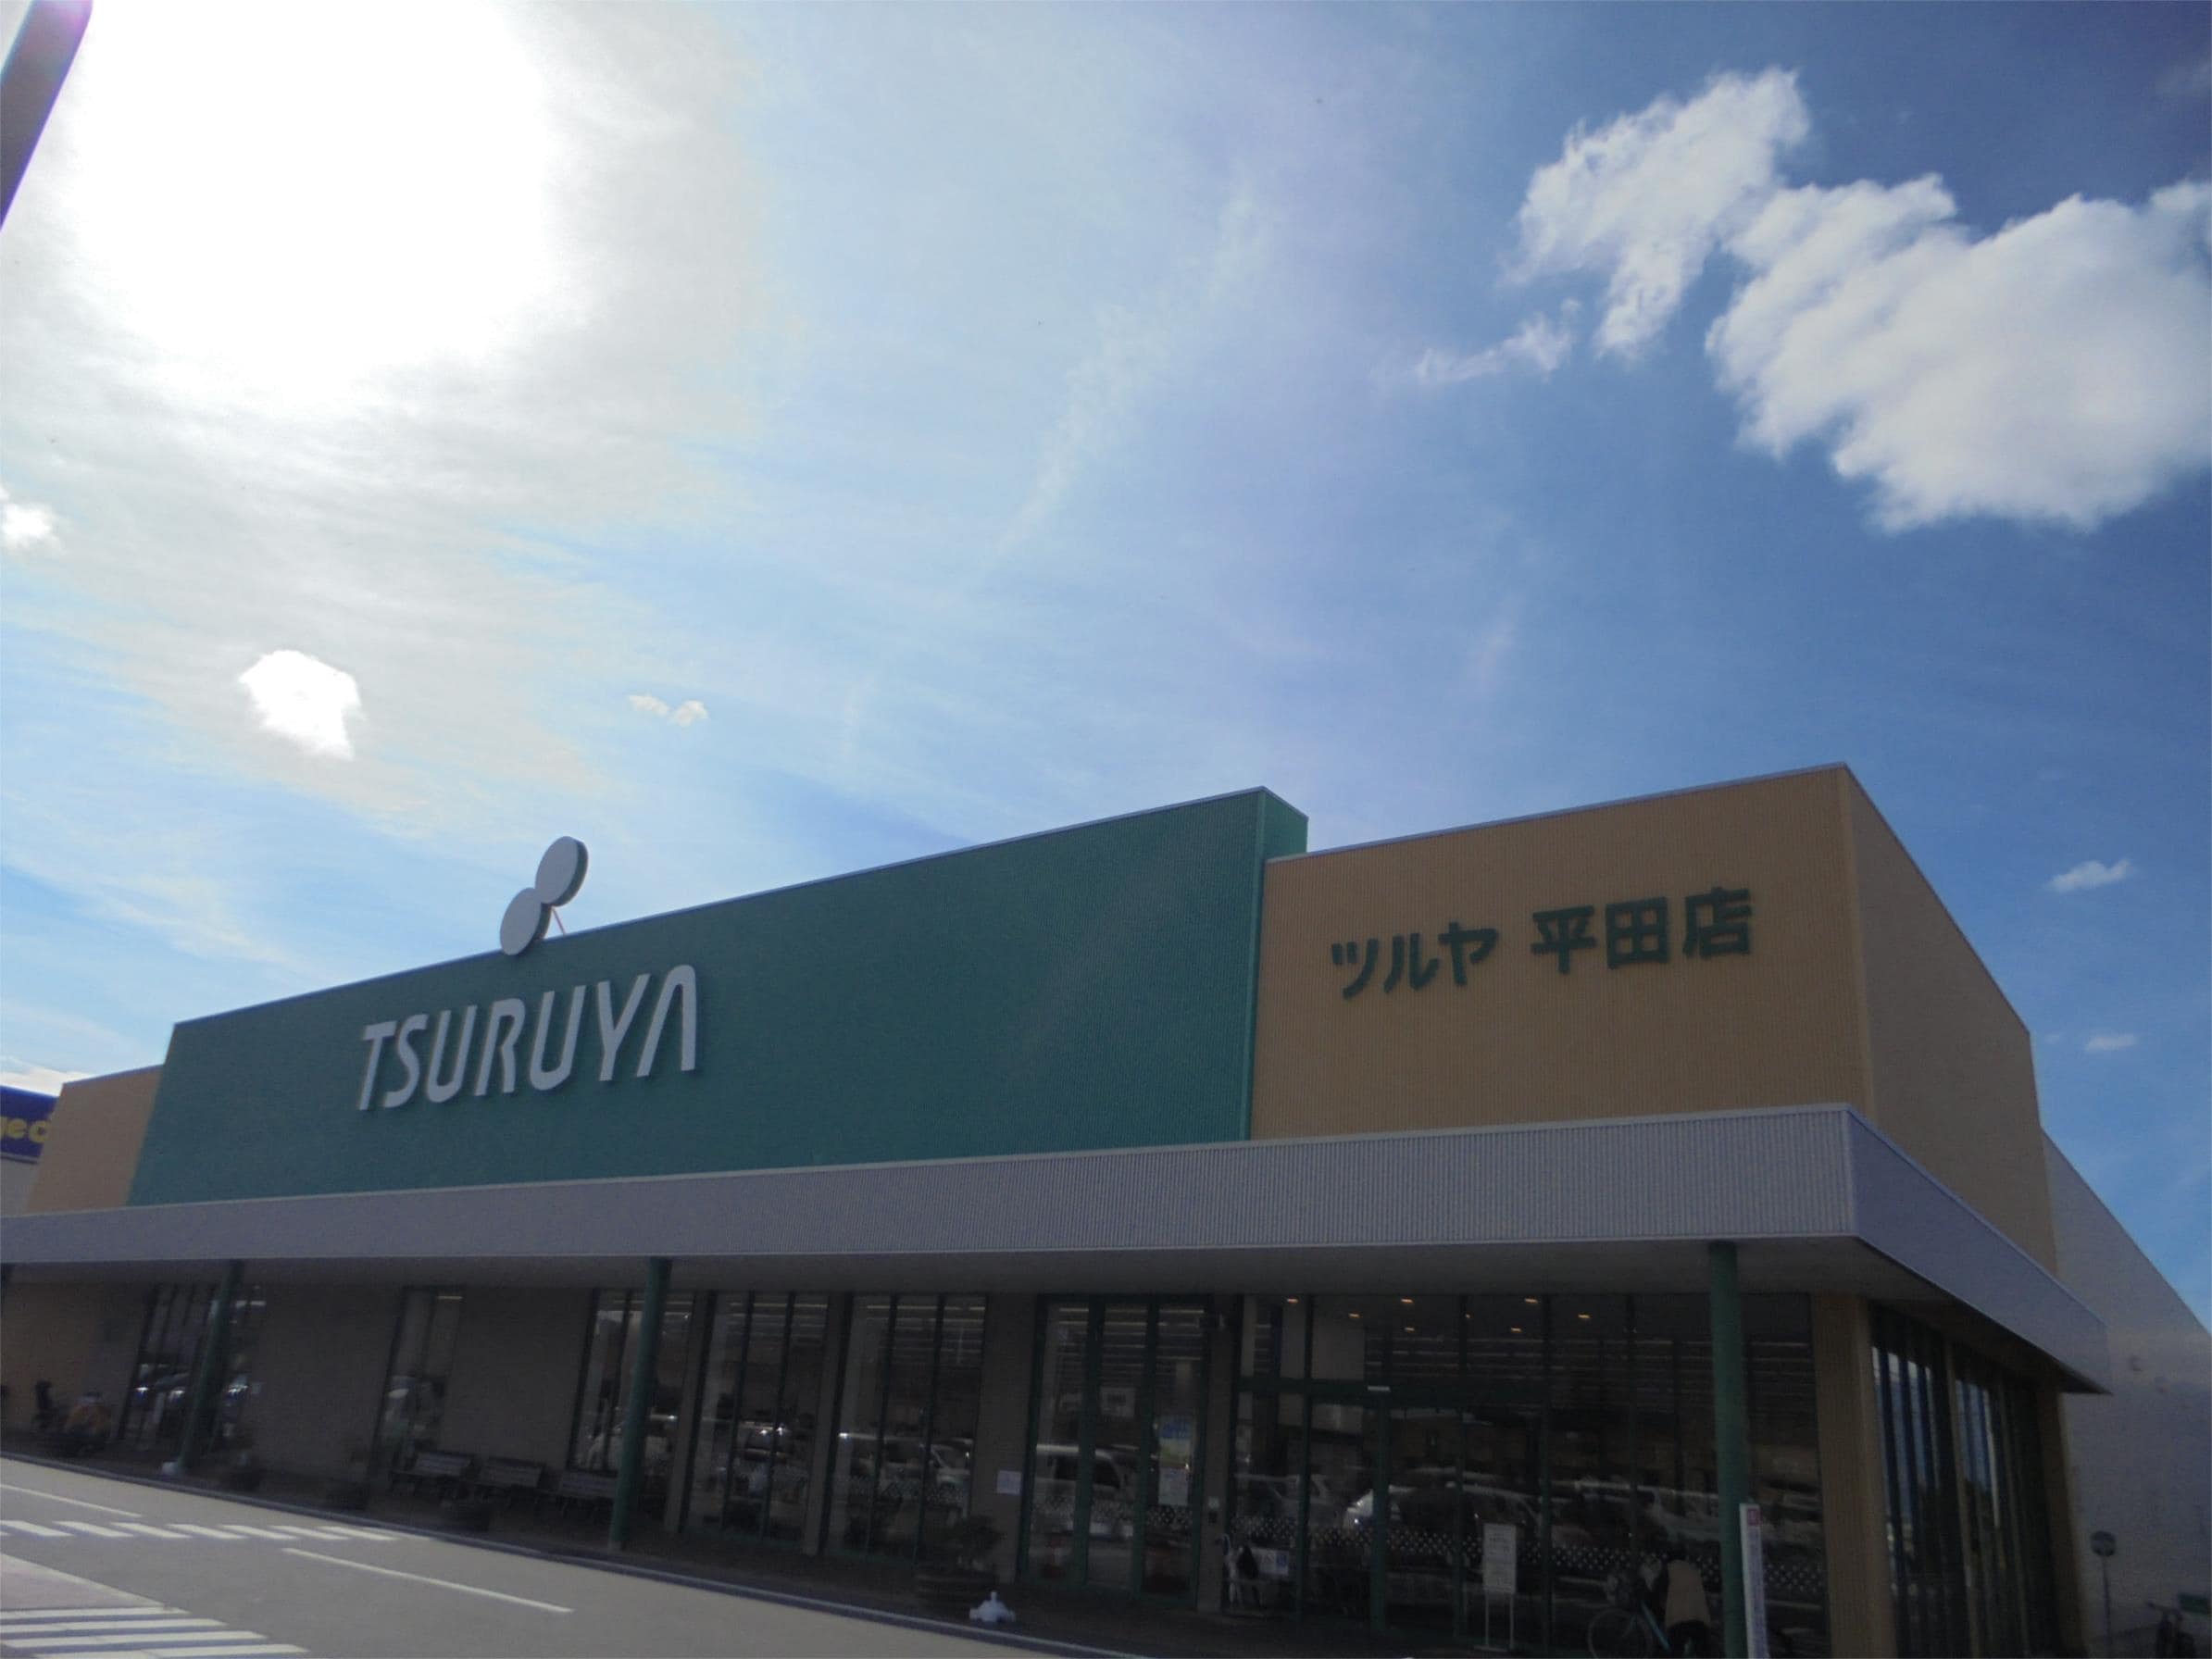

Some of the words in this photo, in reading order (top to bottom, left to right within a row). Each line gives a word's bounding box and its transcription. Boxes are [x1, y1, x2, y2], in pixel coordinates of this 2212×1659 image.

[1331, 921, 1499, 999] ツルヤ
[1530, 885, 1753, 976] 平田店
[358, 964, 697, 1111] TSURUYA
